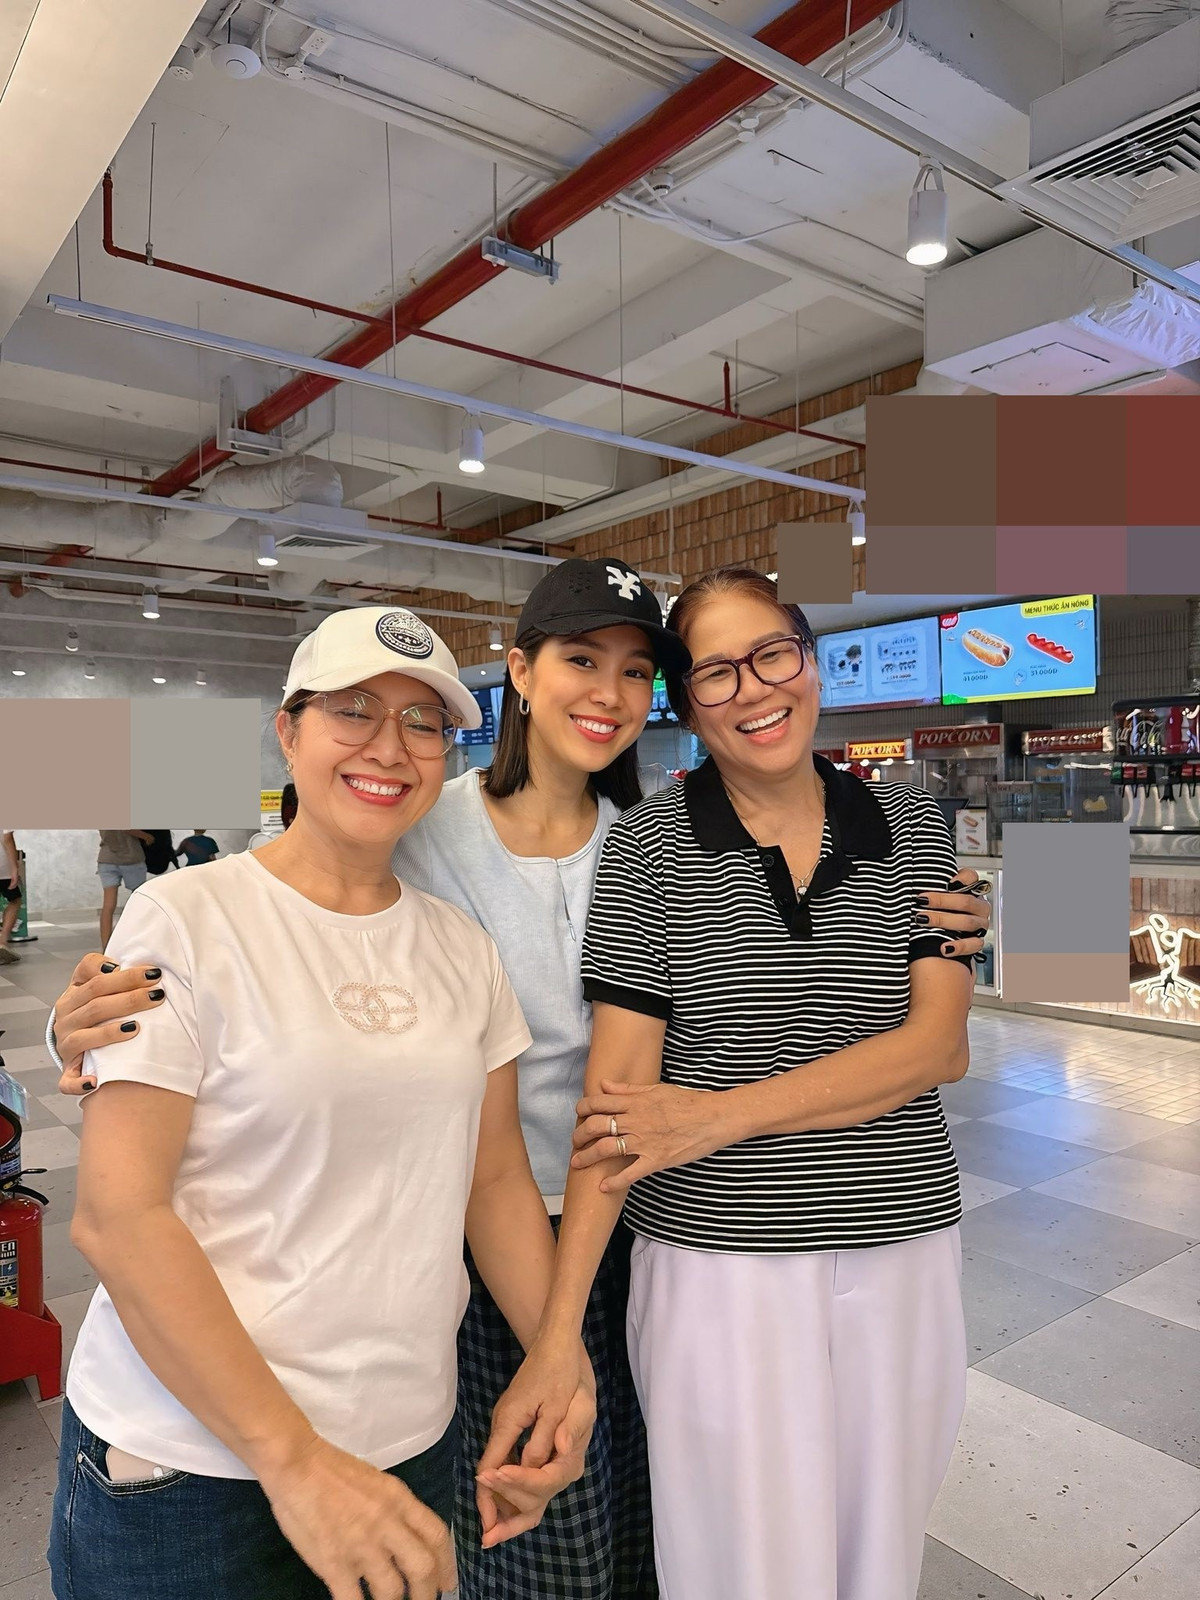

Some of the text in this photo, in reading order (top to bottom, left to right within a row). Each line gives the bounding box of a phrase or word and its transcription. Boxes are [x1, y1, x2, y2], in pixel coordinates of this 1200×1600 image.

[1024, 606, 1042, 615] MENU
[918, 729, 994, 745] POPCORN
[851, 744, 901, 756] POPCORN
